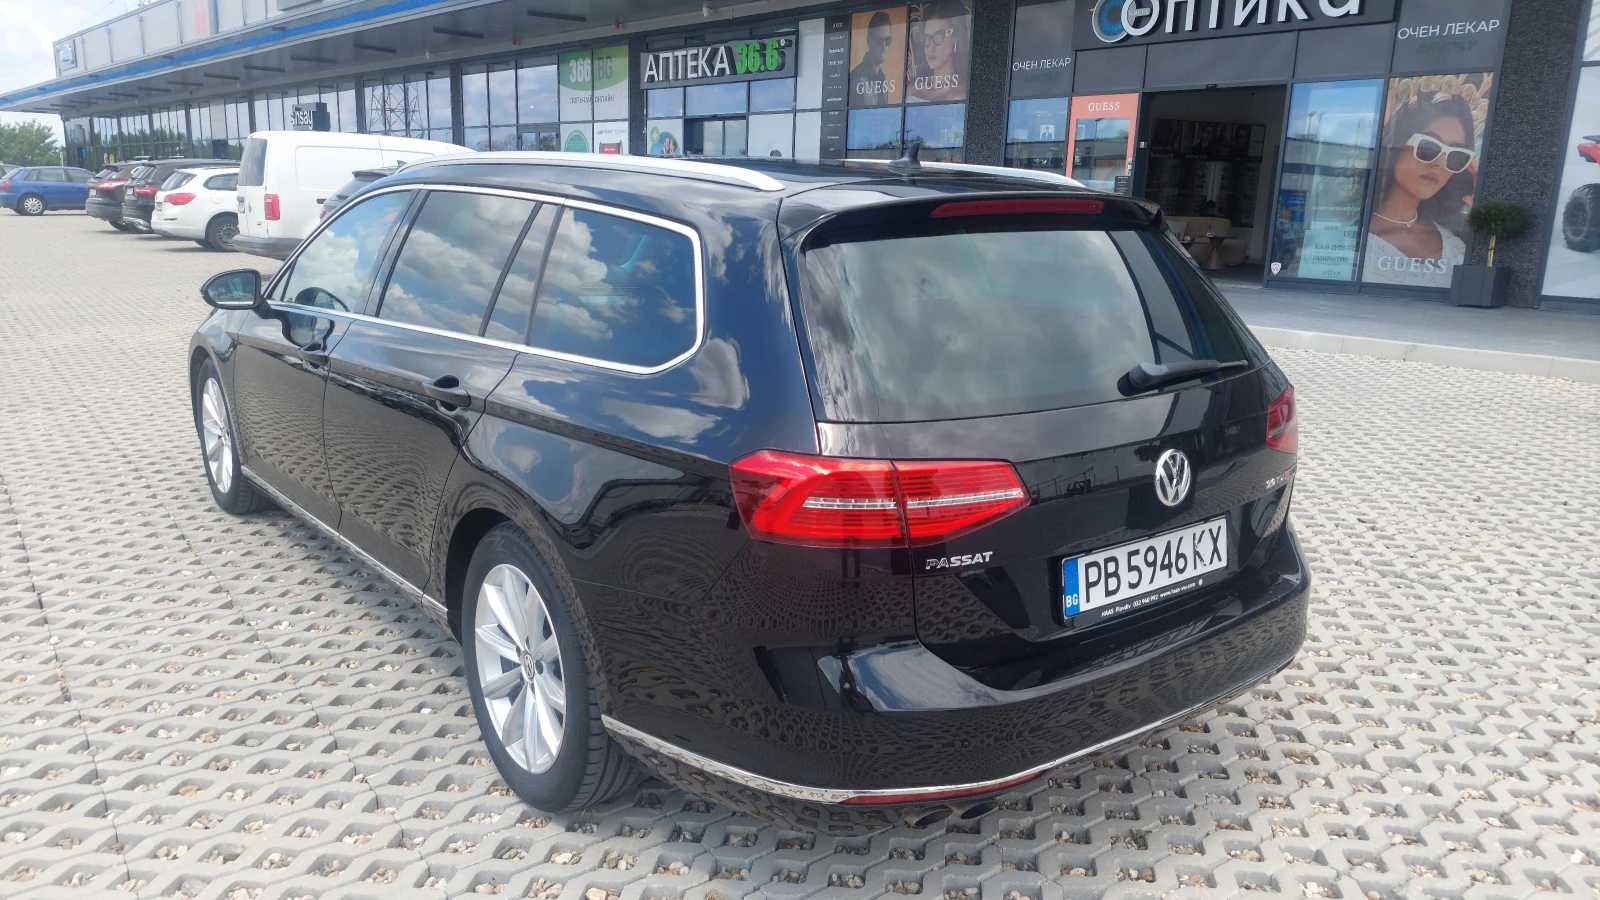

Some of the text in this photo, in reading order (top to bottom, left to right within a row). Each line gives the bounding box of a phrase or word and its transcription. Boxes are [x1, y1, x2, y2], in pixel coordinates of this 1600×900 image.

[1397, 19, 1500, 40] ОЧЕН ЛЕКАР
[644, 45, 731, 83] АПТЕКА
[1012, 57, 1072, 71] ОЧЕН ЛЕКАР
[856, 79, 896, 95] GUESS
[914, 74, 959, 91] GUESS
[1088, 101, 1121, 112] GUESS
[290, 110, 313, 130] snsay
[1377, 255, 1448, 274] GUESS
[925, 551, 993, 570] PASSAT
[1065, 594, 1079, 608] BG
